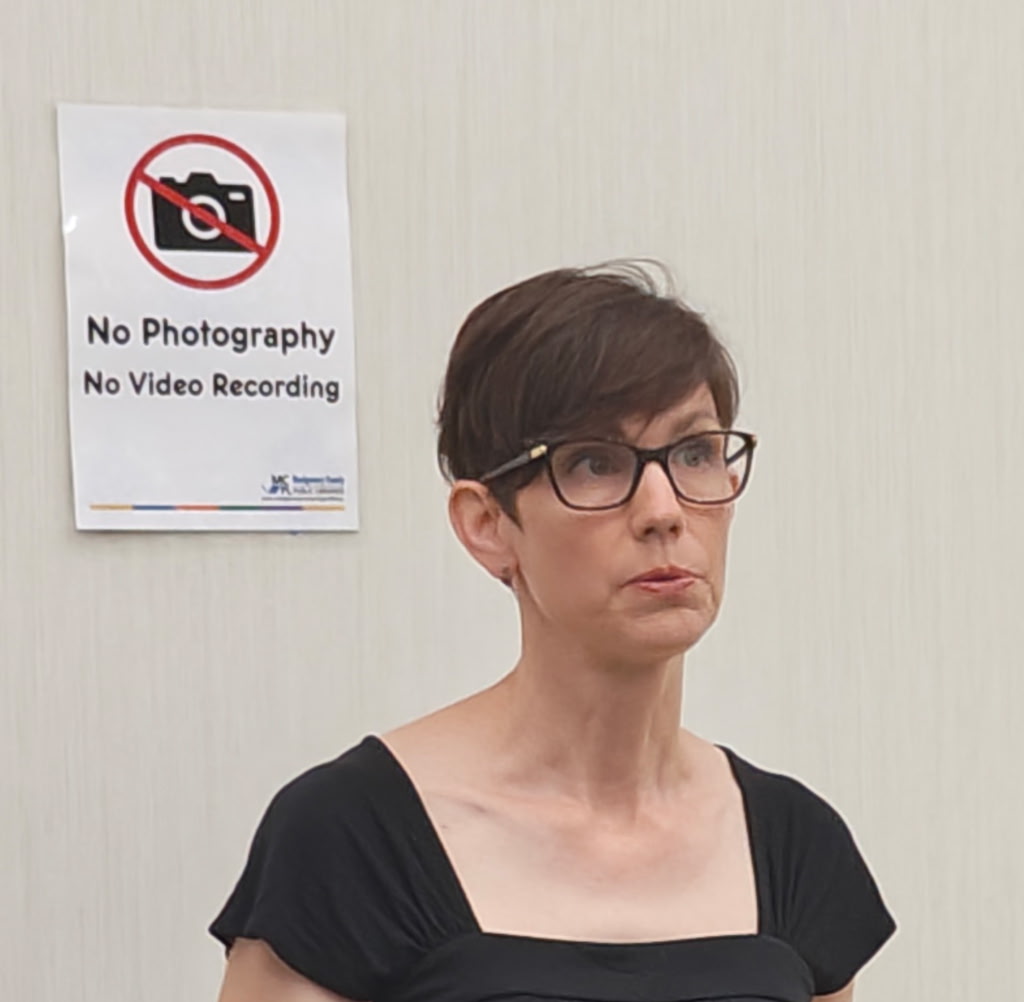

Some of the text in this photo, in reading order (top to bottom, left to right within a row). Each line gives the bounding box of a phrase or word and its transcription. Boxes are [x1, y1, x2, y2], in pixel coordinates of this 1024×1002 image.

[87, 315, 336, 356] No Photography
[84, 369, 340, 404] No Video Recording
